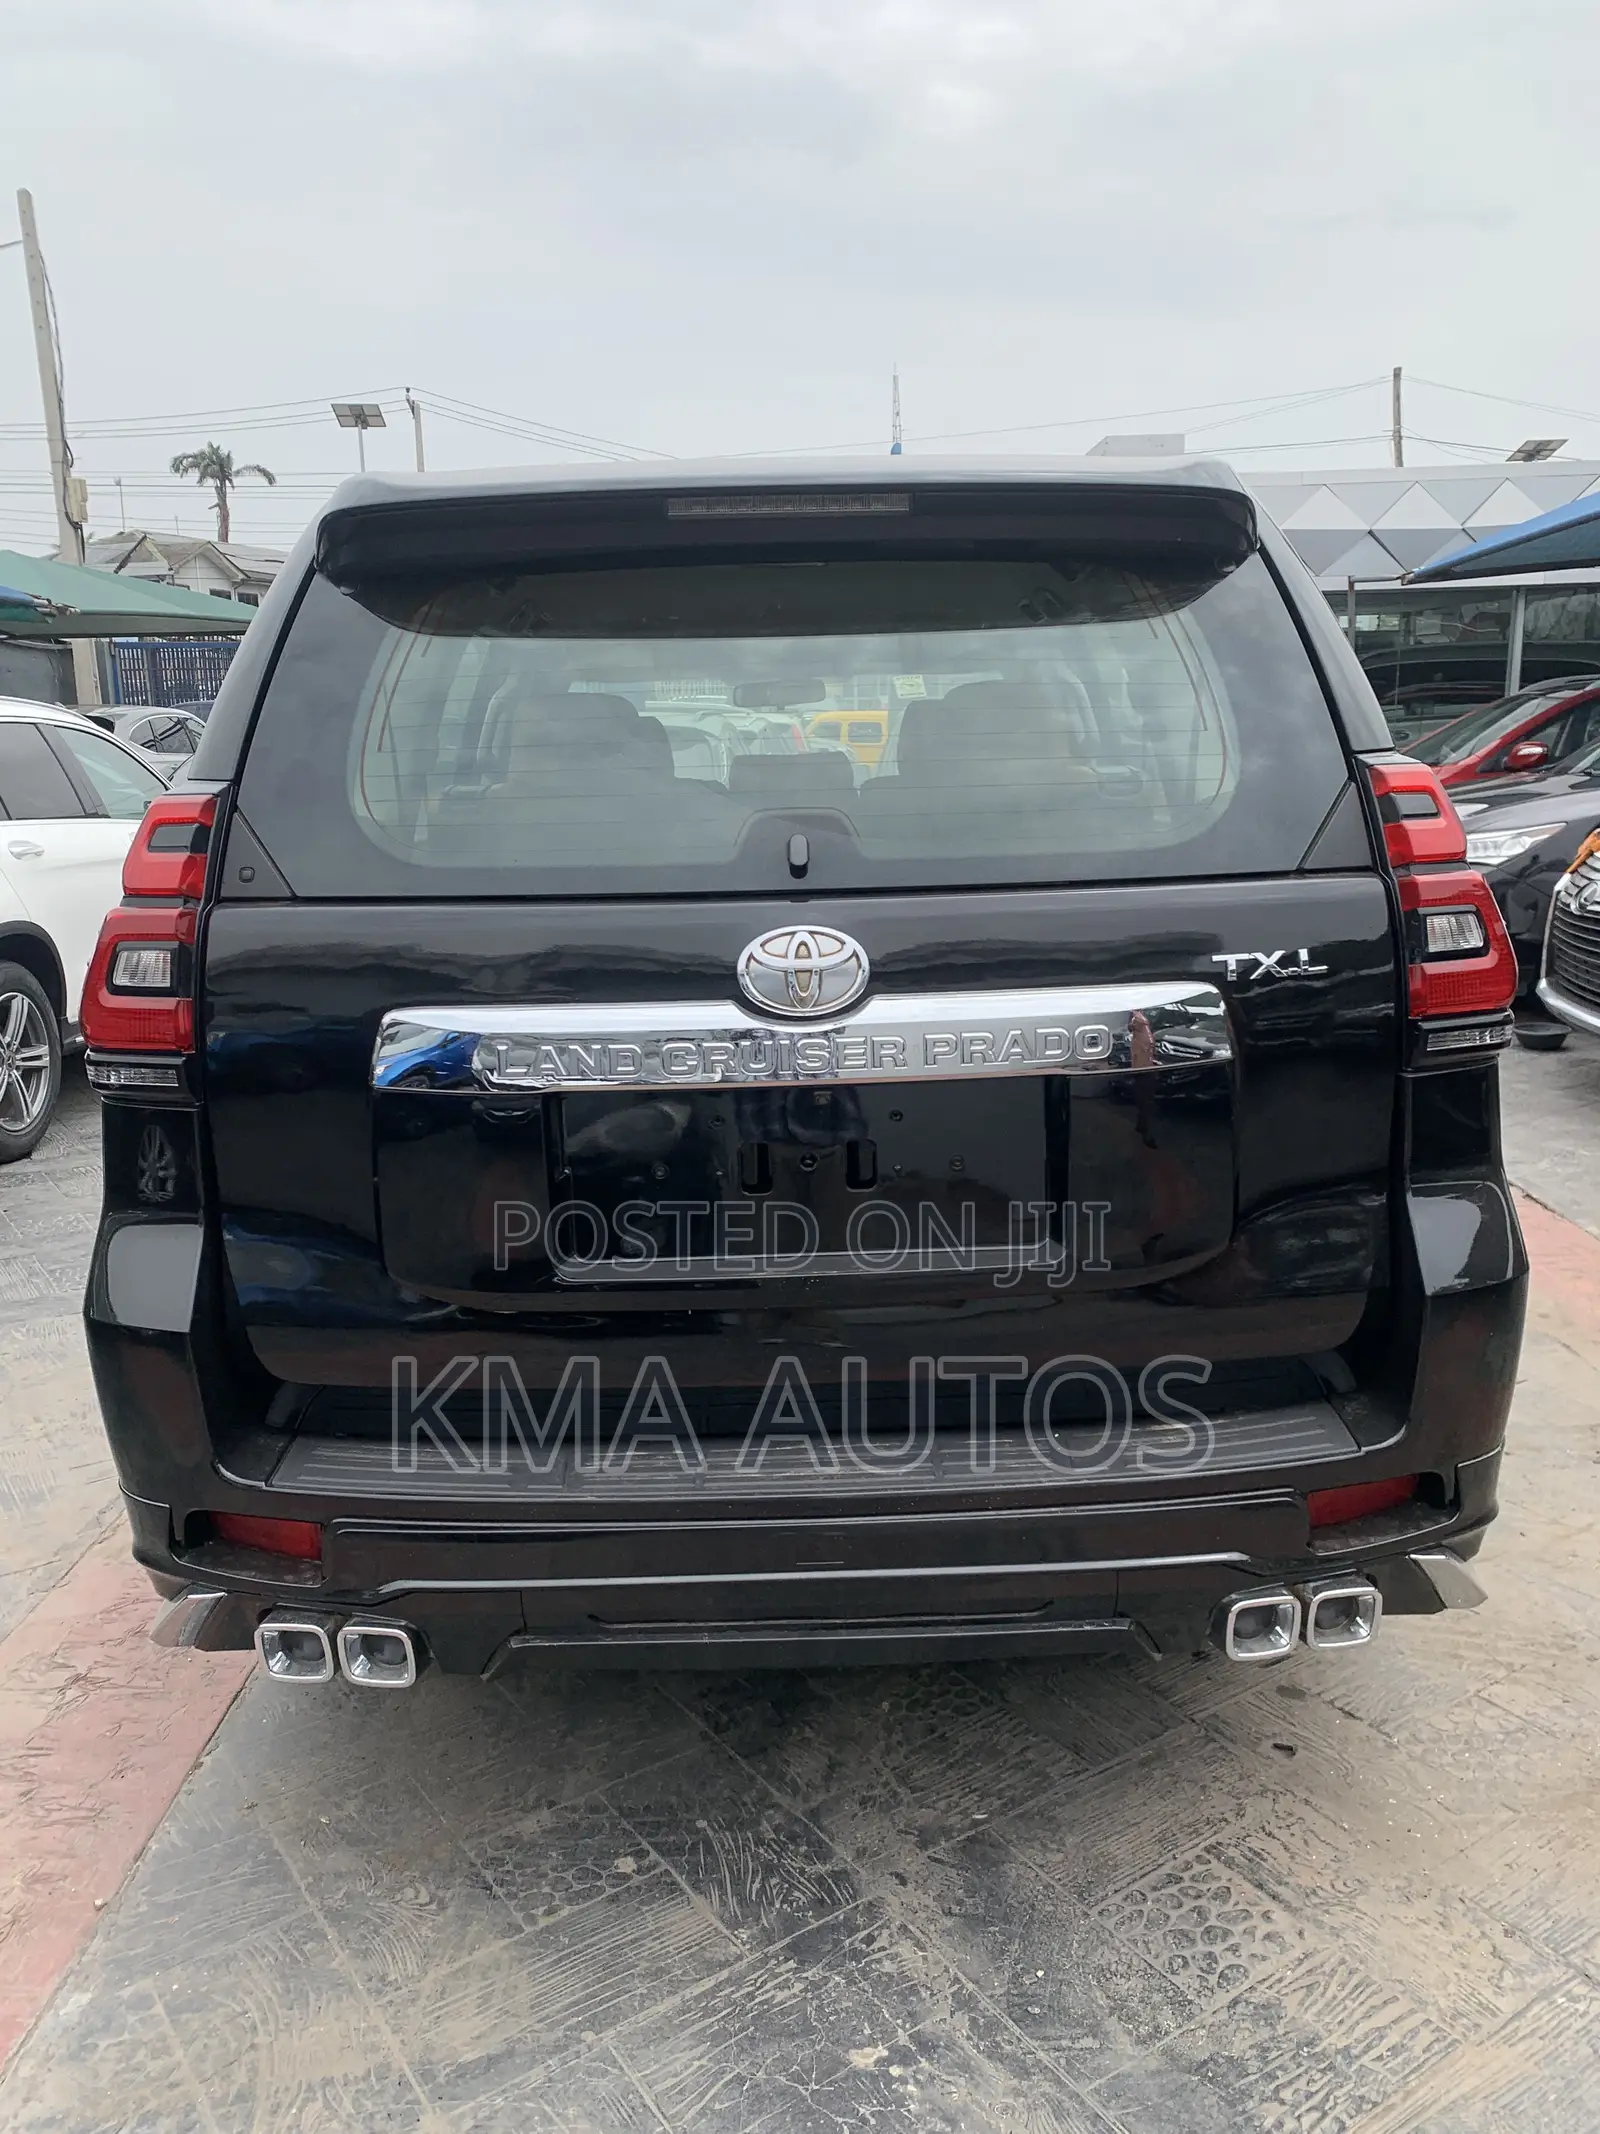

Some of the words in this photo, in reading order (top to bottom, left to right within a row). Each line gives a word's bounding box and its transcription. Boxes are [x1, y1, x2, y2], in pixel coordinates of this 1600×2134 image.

[495, 1043, 642, 1079] LAND
[660, 1034, 908, 1079] CRUISER
[922, 1024, 1112, 1068] PRADO
